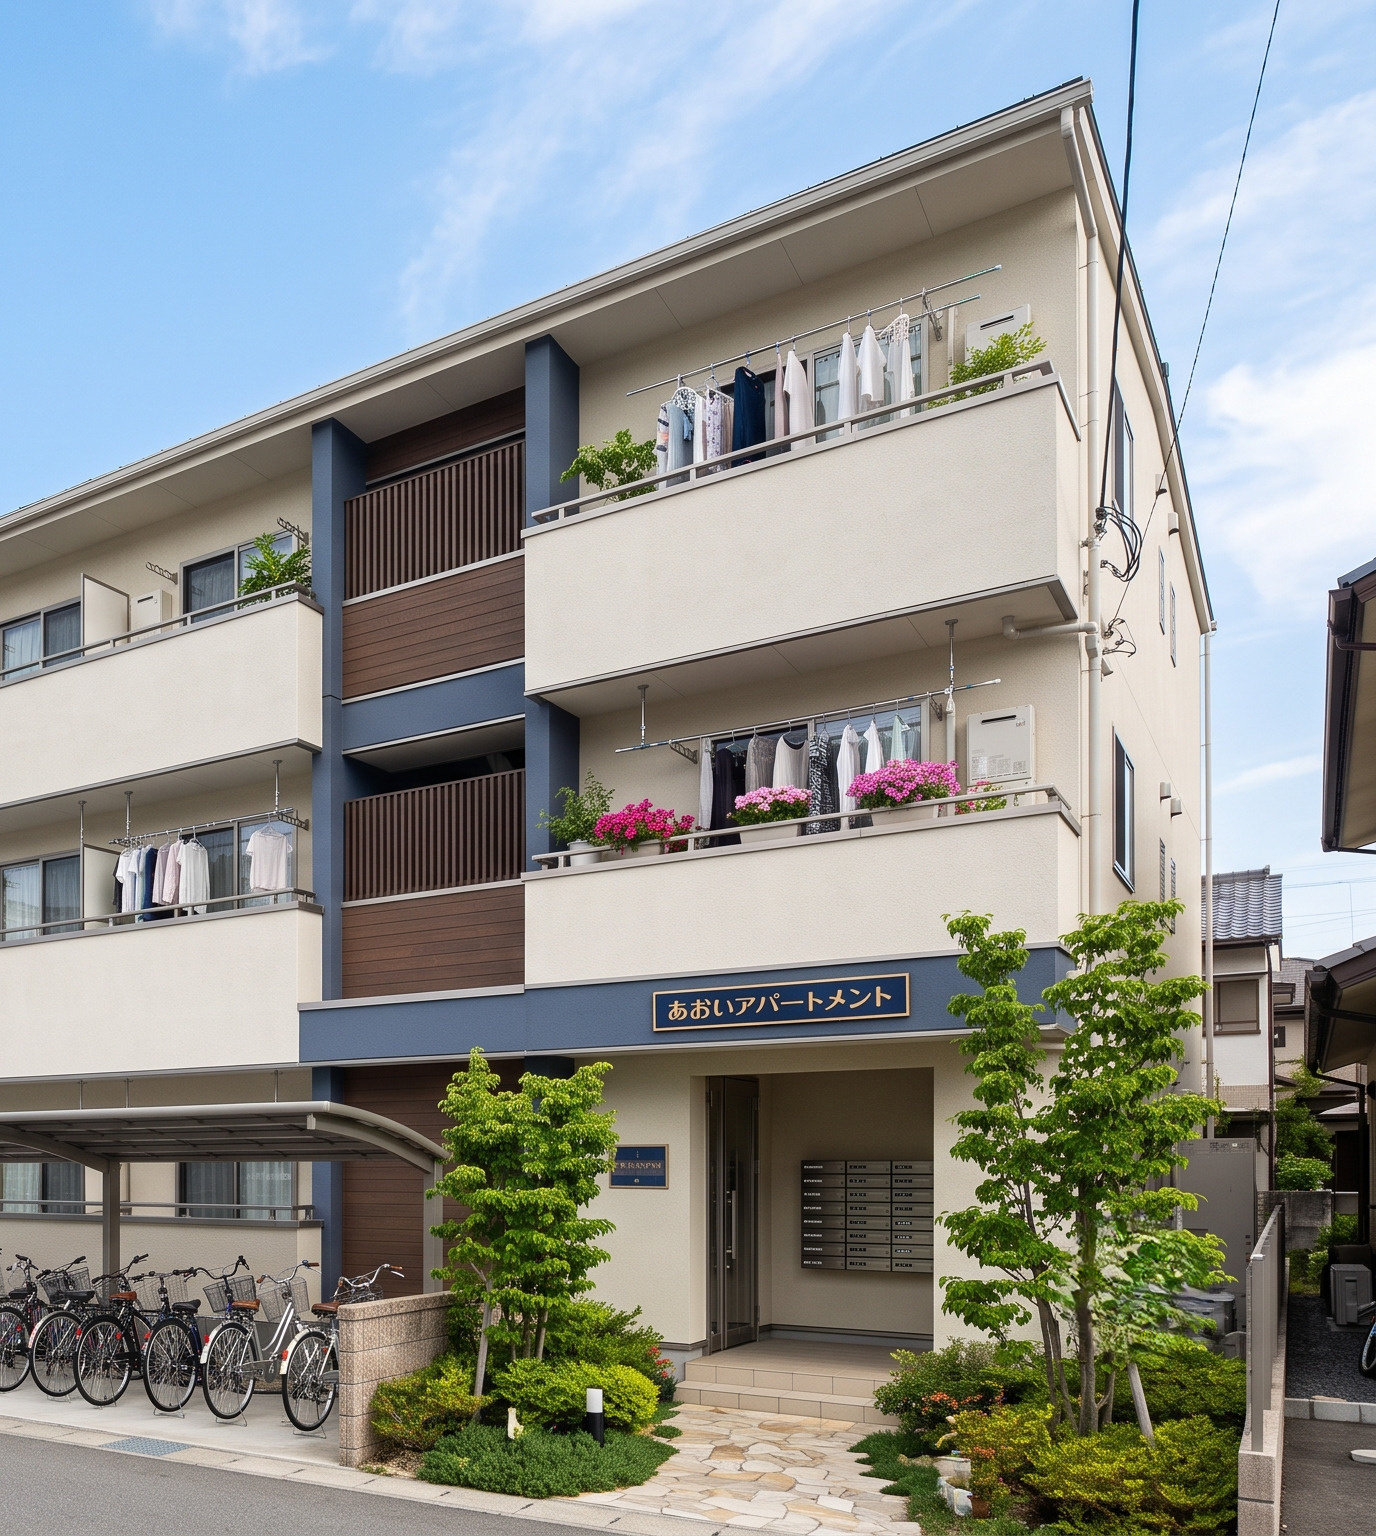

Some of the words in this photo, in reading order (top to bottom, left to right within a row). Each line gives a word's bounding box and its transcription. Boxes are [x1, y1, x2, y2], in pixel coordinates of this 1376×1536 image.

[668, 985, 892, 1021] あおいアパートメント
